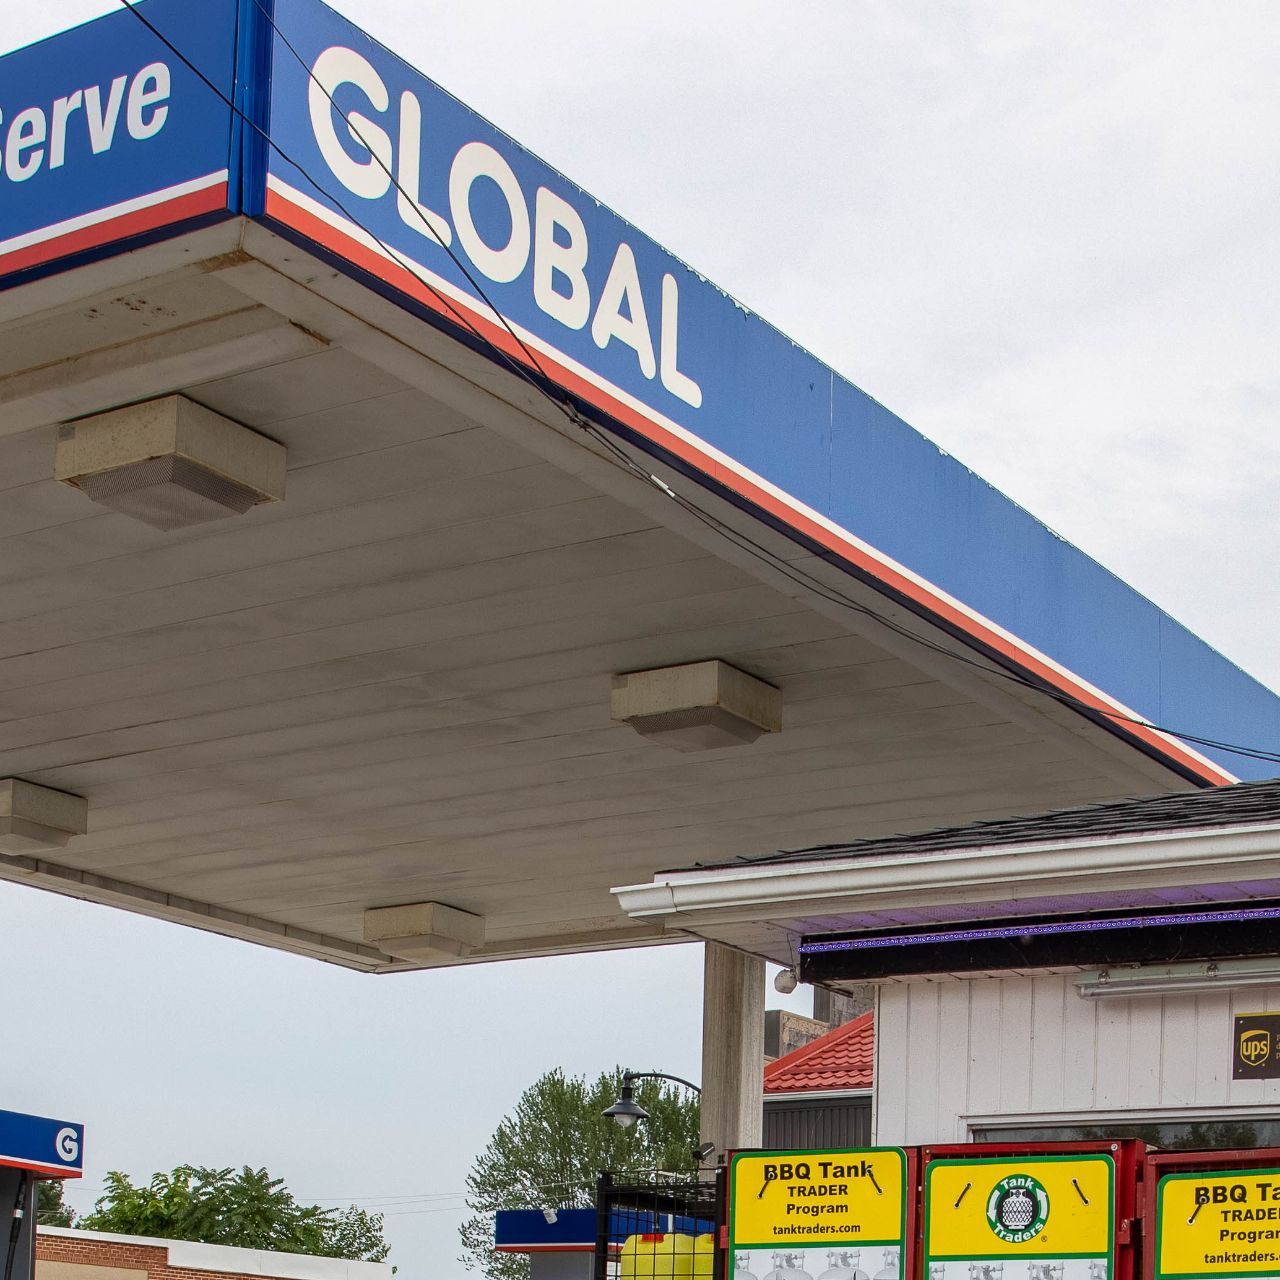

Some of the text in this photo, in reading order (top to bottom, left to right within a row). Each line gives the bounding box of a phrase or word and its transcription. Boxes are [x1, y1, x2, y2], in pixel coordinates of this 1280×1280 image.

[308, 45, 703, 409] GLOBAL
[1243, 1041, 1267, 1060] ups
[764, 1161, 873, 1181] BBQ Tank
[787, 1184, 848, 1197] TRADER
[1000, 1178, 1033, 1190] Tank
[1194, 1184, 1248, 1205] BBQ
[786, 1203, 848, 1217] Program
[773, 1223, 861, 1235] tanktraders.com
[994, 1222, 1044, 1243] Traders
